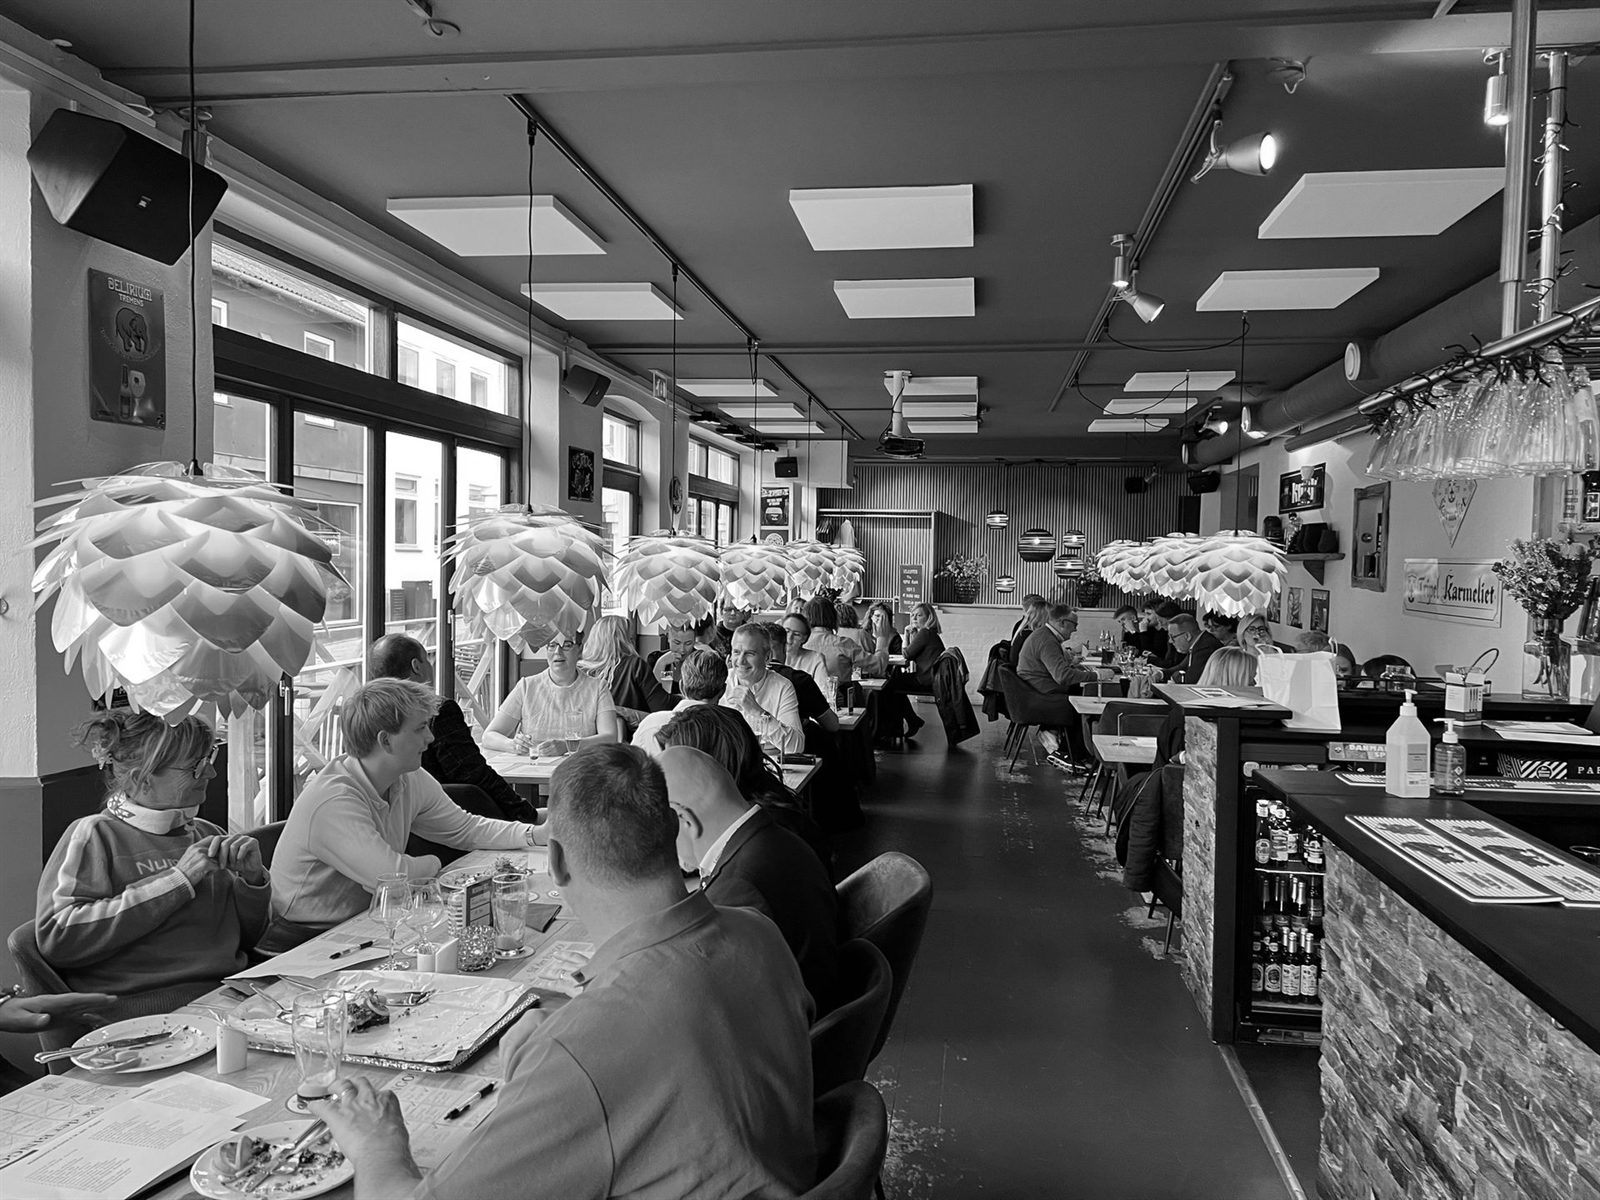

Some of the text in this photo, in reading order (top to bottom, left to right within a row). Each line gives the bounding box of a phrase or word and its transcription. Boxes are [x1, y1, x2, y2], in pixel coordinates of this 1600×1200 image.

[107, 277, 152, 302] DELIRIUM
[118, 293, 144, 307] TREMENS
[1443, 574, 1495, 605] Karmeliet
